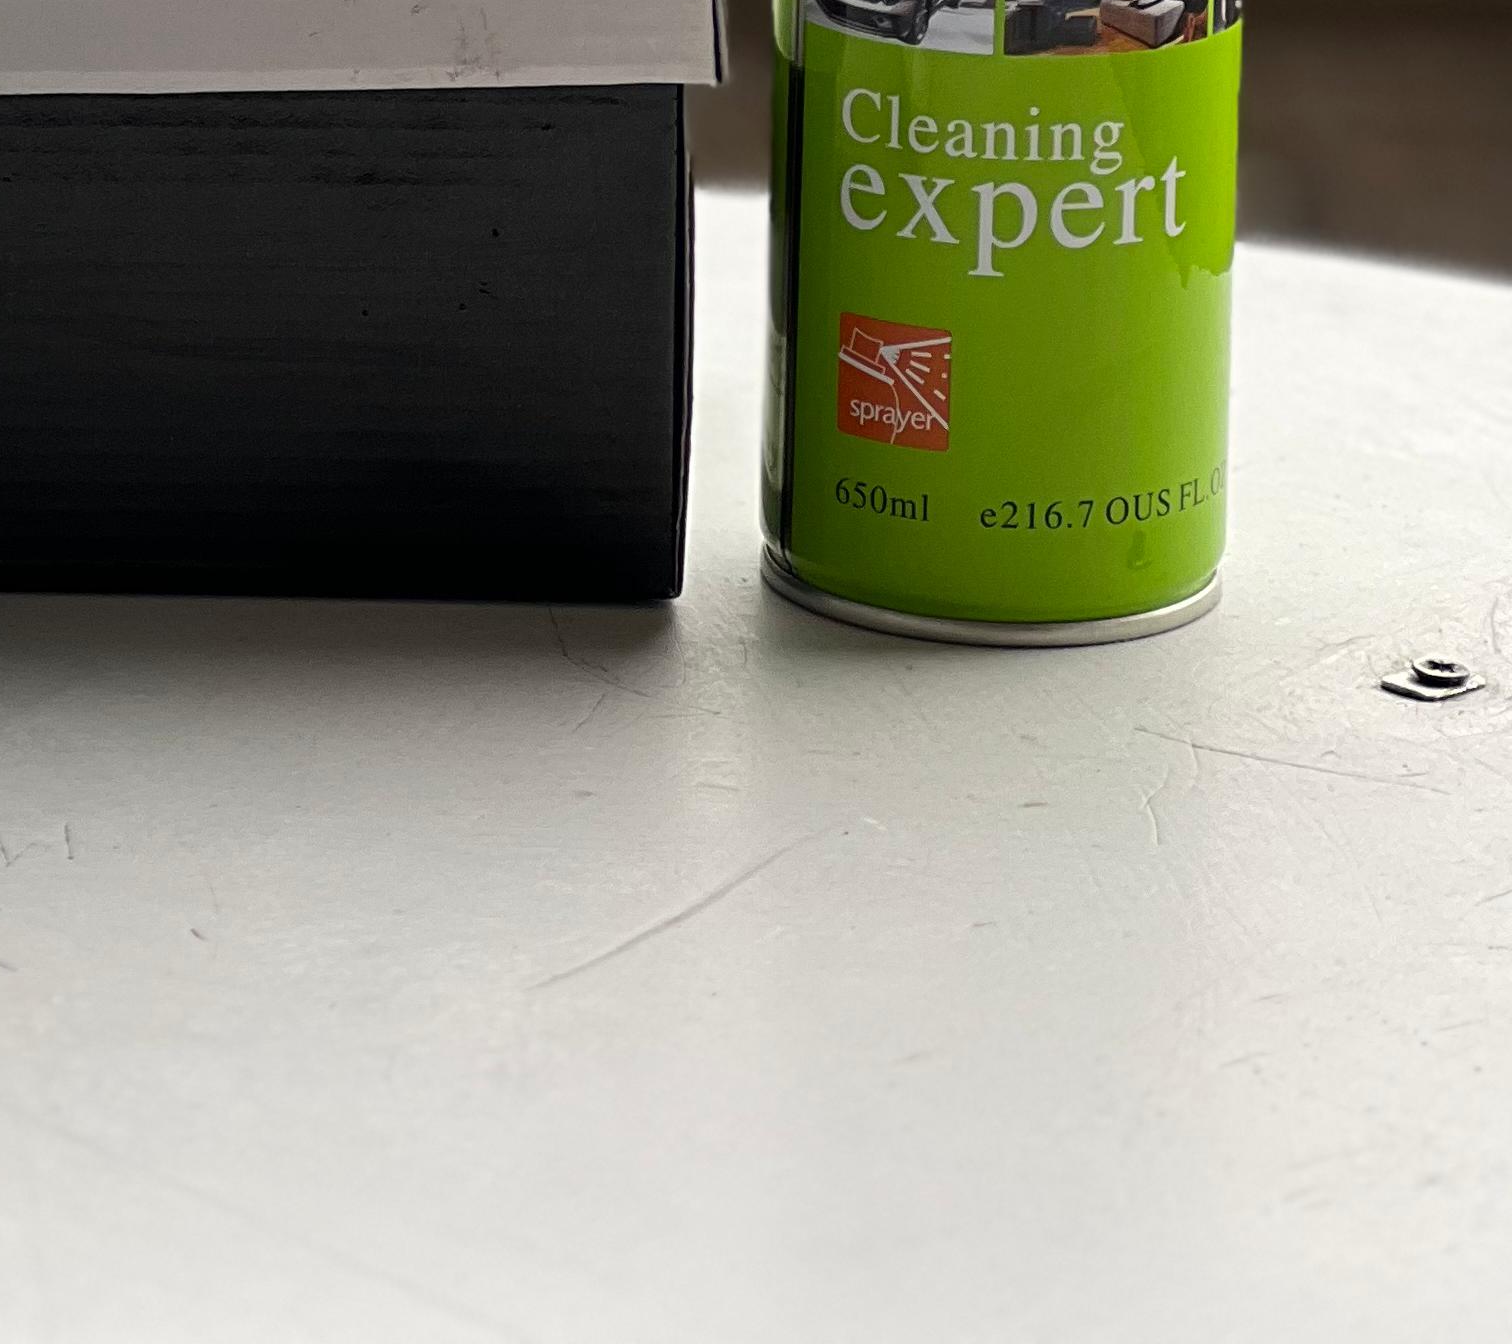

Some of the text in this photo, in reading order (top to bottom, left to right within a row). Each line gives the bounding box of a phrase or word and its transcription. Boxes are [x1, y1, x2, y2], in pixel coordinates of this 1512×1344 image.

[841, 88, 1125, 176] Cleaning
[840, 156, 1187, 278] expert
[849, 399, 935, 433] sprayer
[835, 477, 930, 523] 650ml
